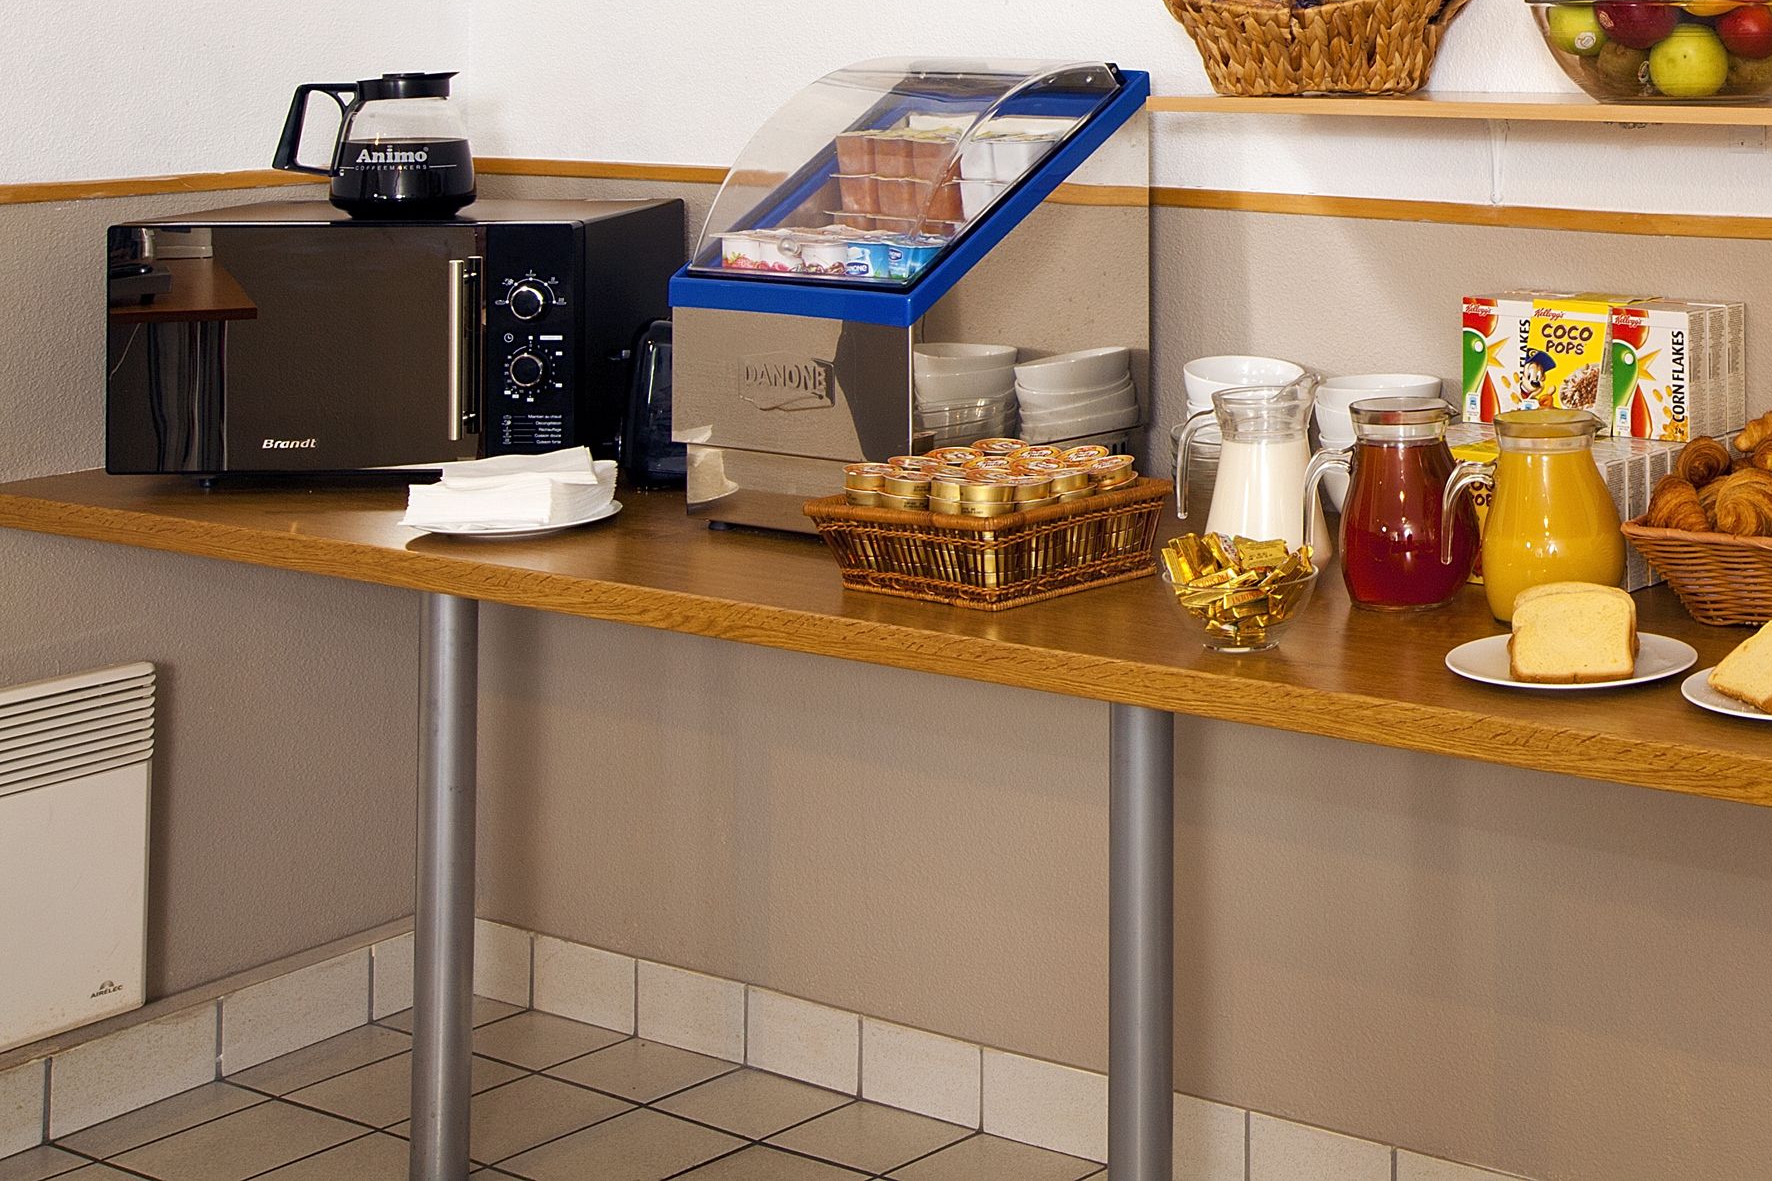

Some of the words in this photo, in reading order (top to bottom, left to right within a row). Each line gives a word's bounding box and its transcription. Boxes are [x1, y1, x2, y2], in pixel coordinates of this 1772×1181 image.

[356, 145, 428, 163] Animo
[1534, 307, 1565, 321] Kellogg's
[1541, 323, 1593, 341] COCO
[1545, 340, 1585, 355] POPS
[1671, 330, 1685, 381] FLAKES
[744, 364, 826, 391] DANONE
[1672, 384, 1686, 423] CORN
[262, 438, 317, 449] Brandt
[91, 984, 123, 999] AIRELEC
